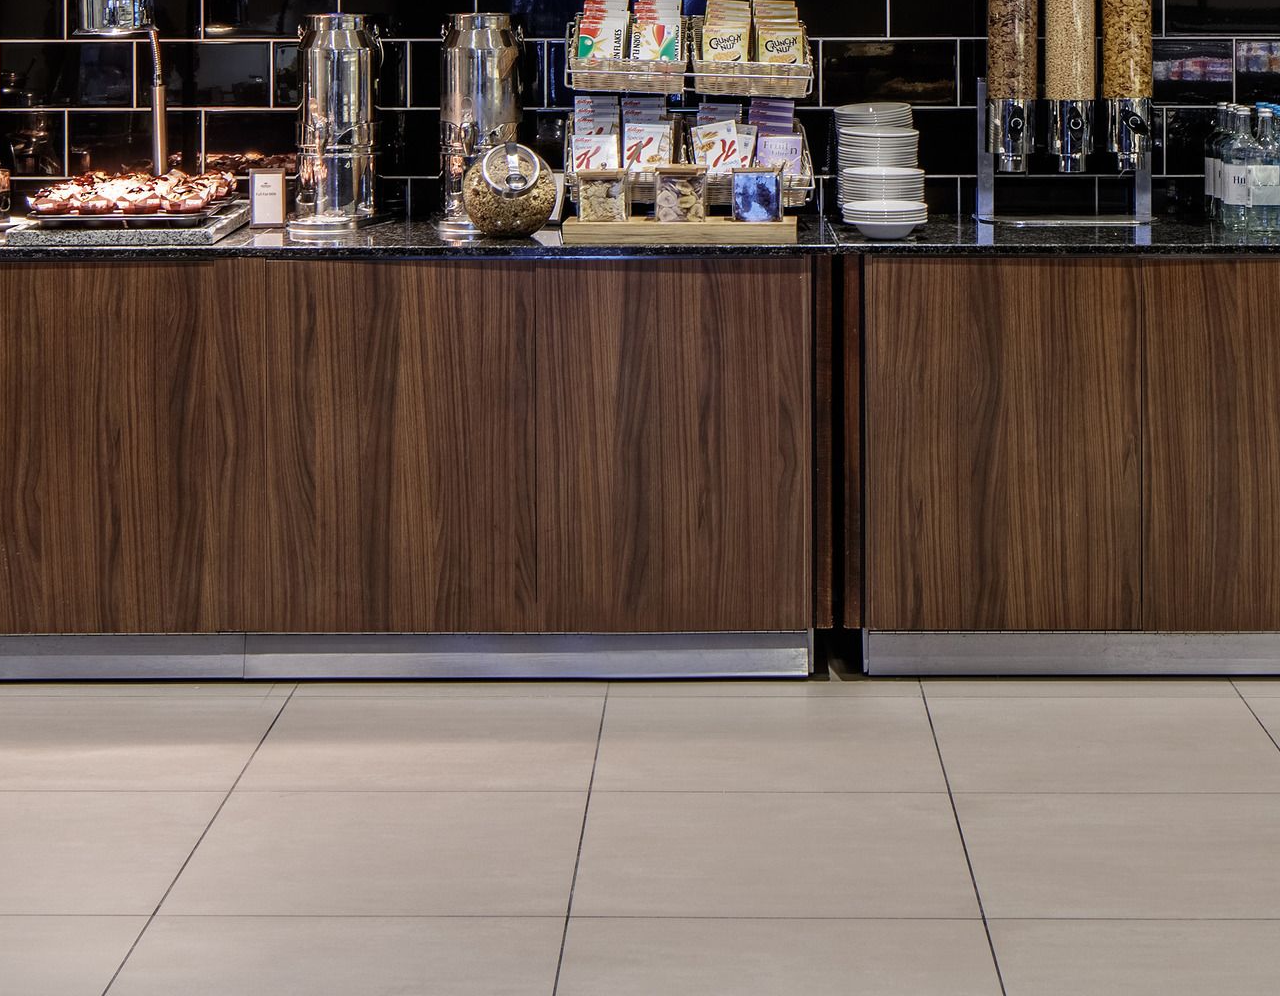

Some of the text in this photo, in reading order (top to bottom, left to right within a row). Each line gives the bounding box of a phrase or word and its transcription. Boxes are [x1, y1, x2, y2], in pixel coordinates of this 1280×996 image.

[709, 34, 742, 49] CRUNCHY
[765, 37, 797, 52] CRUNCHY
[776, 46, 790, 54] NUT
